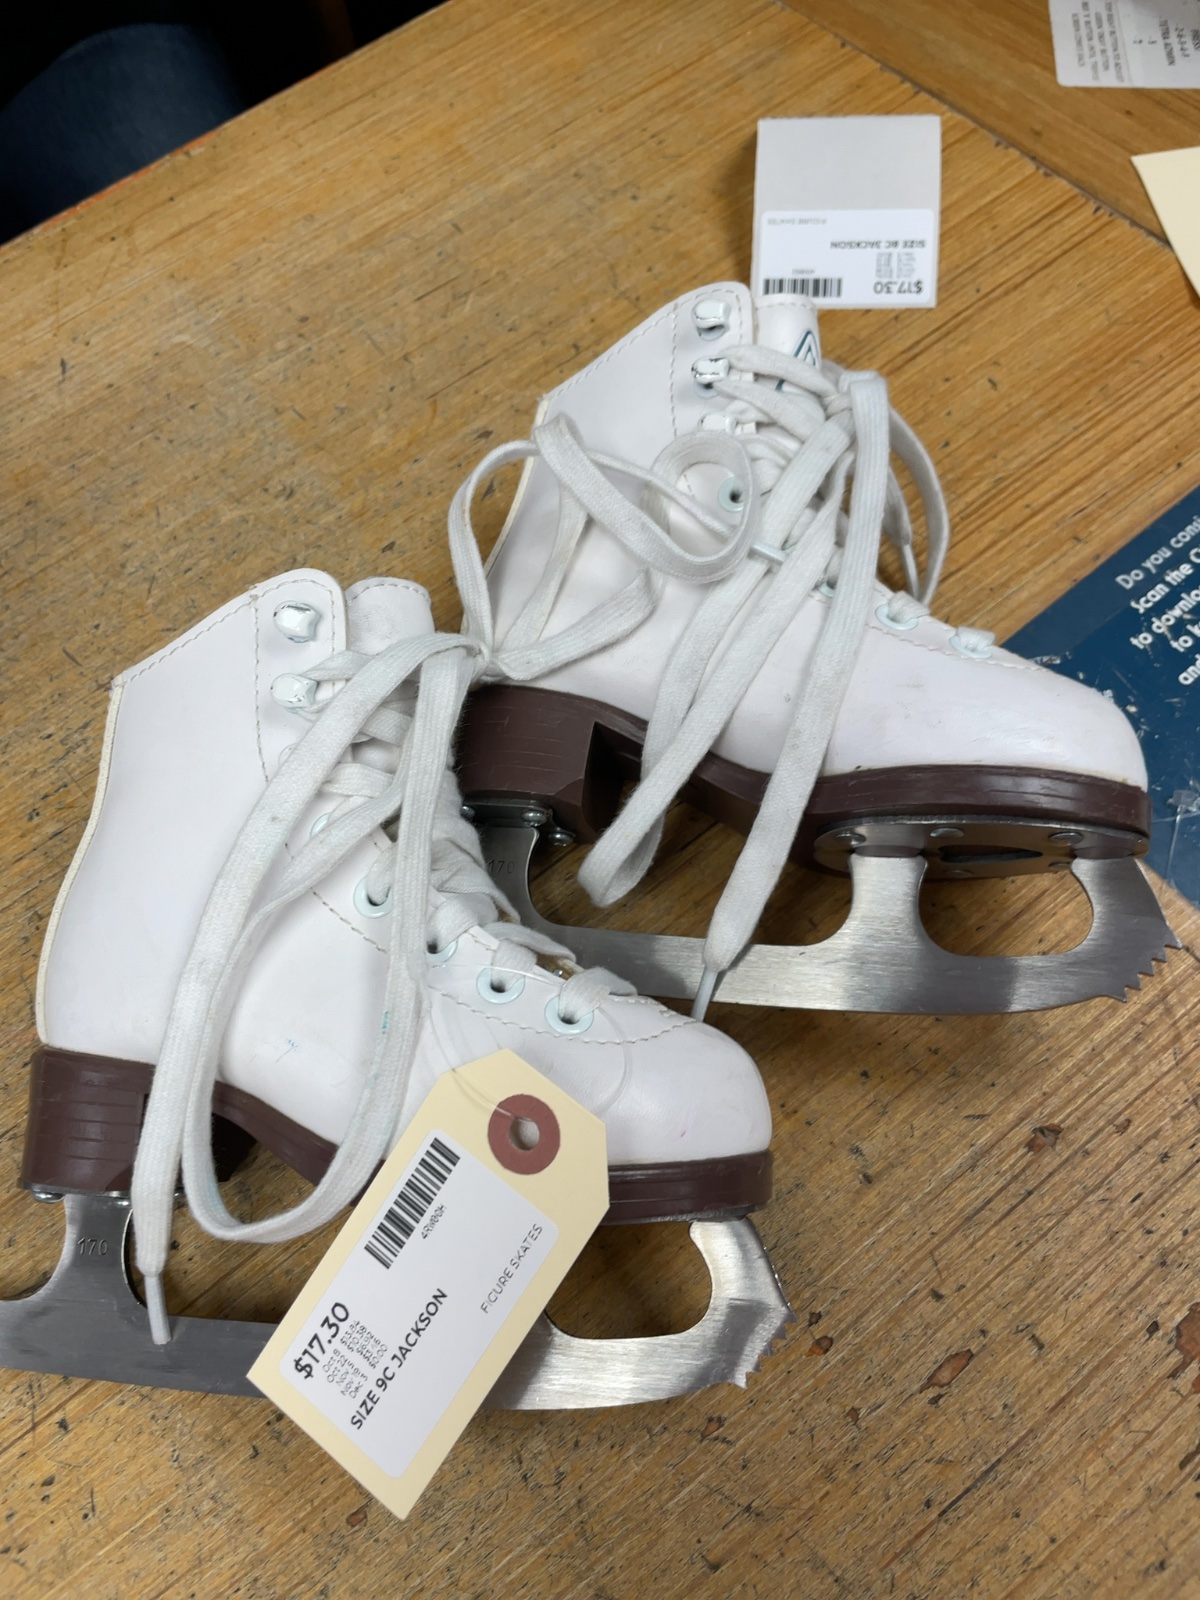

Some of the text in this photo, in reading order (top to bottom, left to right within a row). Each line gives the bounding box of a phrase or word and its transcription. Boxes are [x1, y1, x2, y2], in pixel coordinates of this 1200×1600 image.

[830, 240, 881, 249] JACKSON
[903, 240, 926, 249] SIZE
[873, 281, 924, 295] $17.30
[1115, 569, 1145, 590] Do
[1141, 546, 1173, 574] you
[1130, 563, 1194, 614] Scan the
[1130, 586, 1200, 650] to downlo
[1170, 635, 1194, 652] to
[488, 859, 515, 874] 170
[77, 1237, 108, 1256] 170
[480, 1223, 543, 1314] FIGURE SKATES
[293, 1302, 350, 1380] $17.30
[326, 1325, 367, 1383] Oct 22 $10.38
[350, 1288, 448, 1430] SIZE 9C JACKSON
[322, 1356, 337, 1373] Oct
[349, 1343, 388, 1399] Dec 3 $0.00
[336, 1368, 350, 1387] Nov
[340, 1377, 354, 1396] Nov
